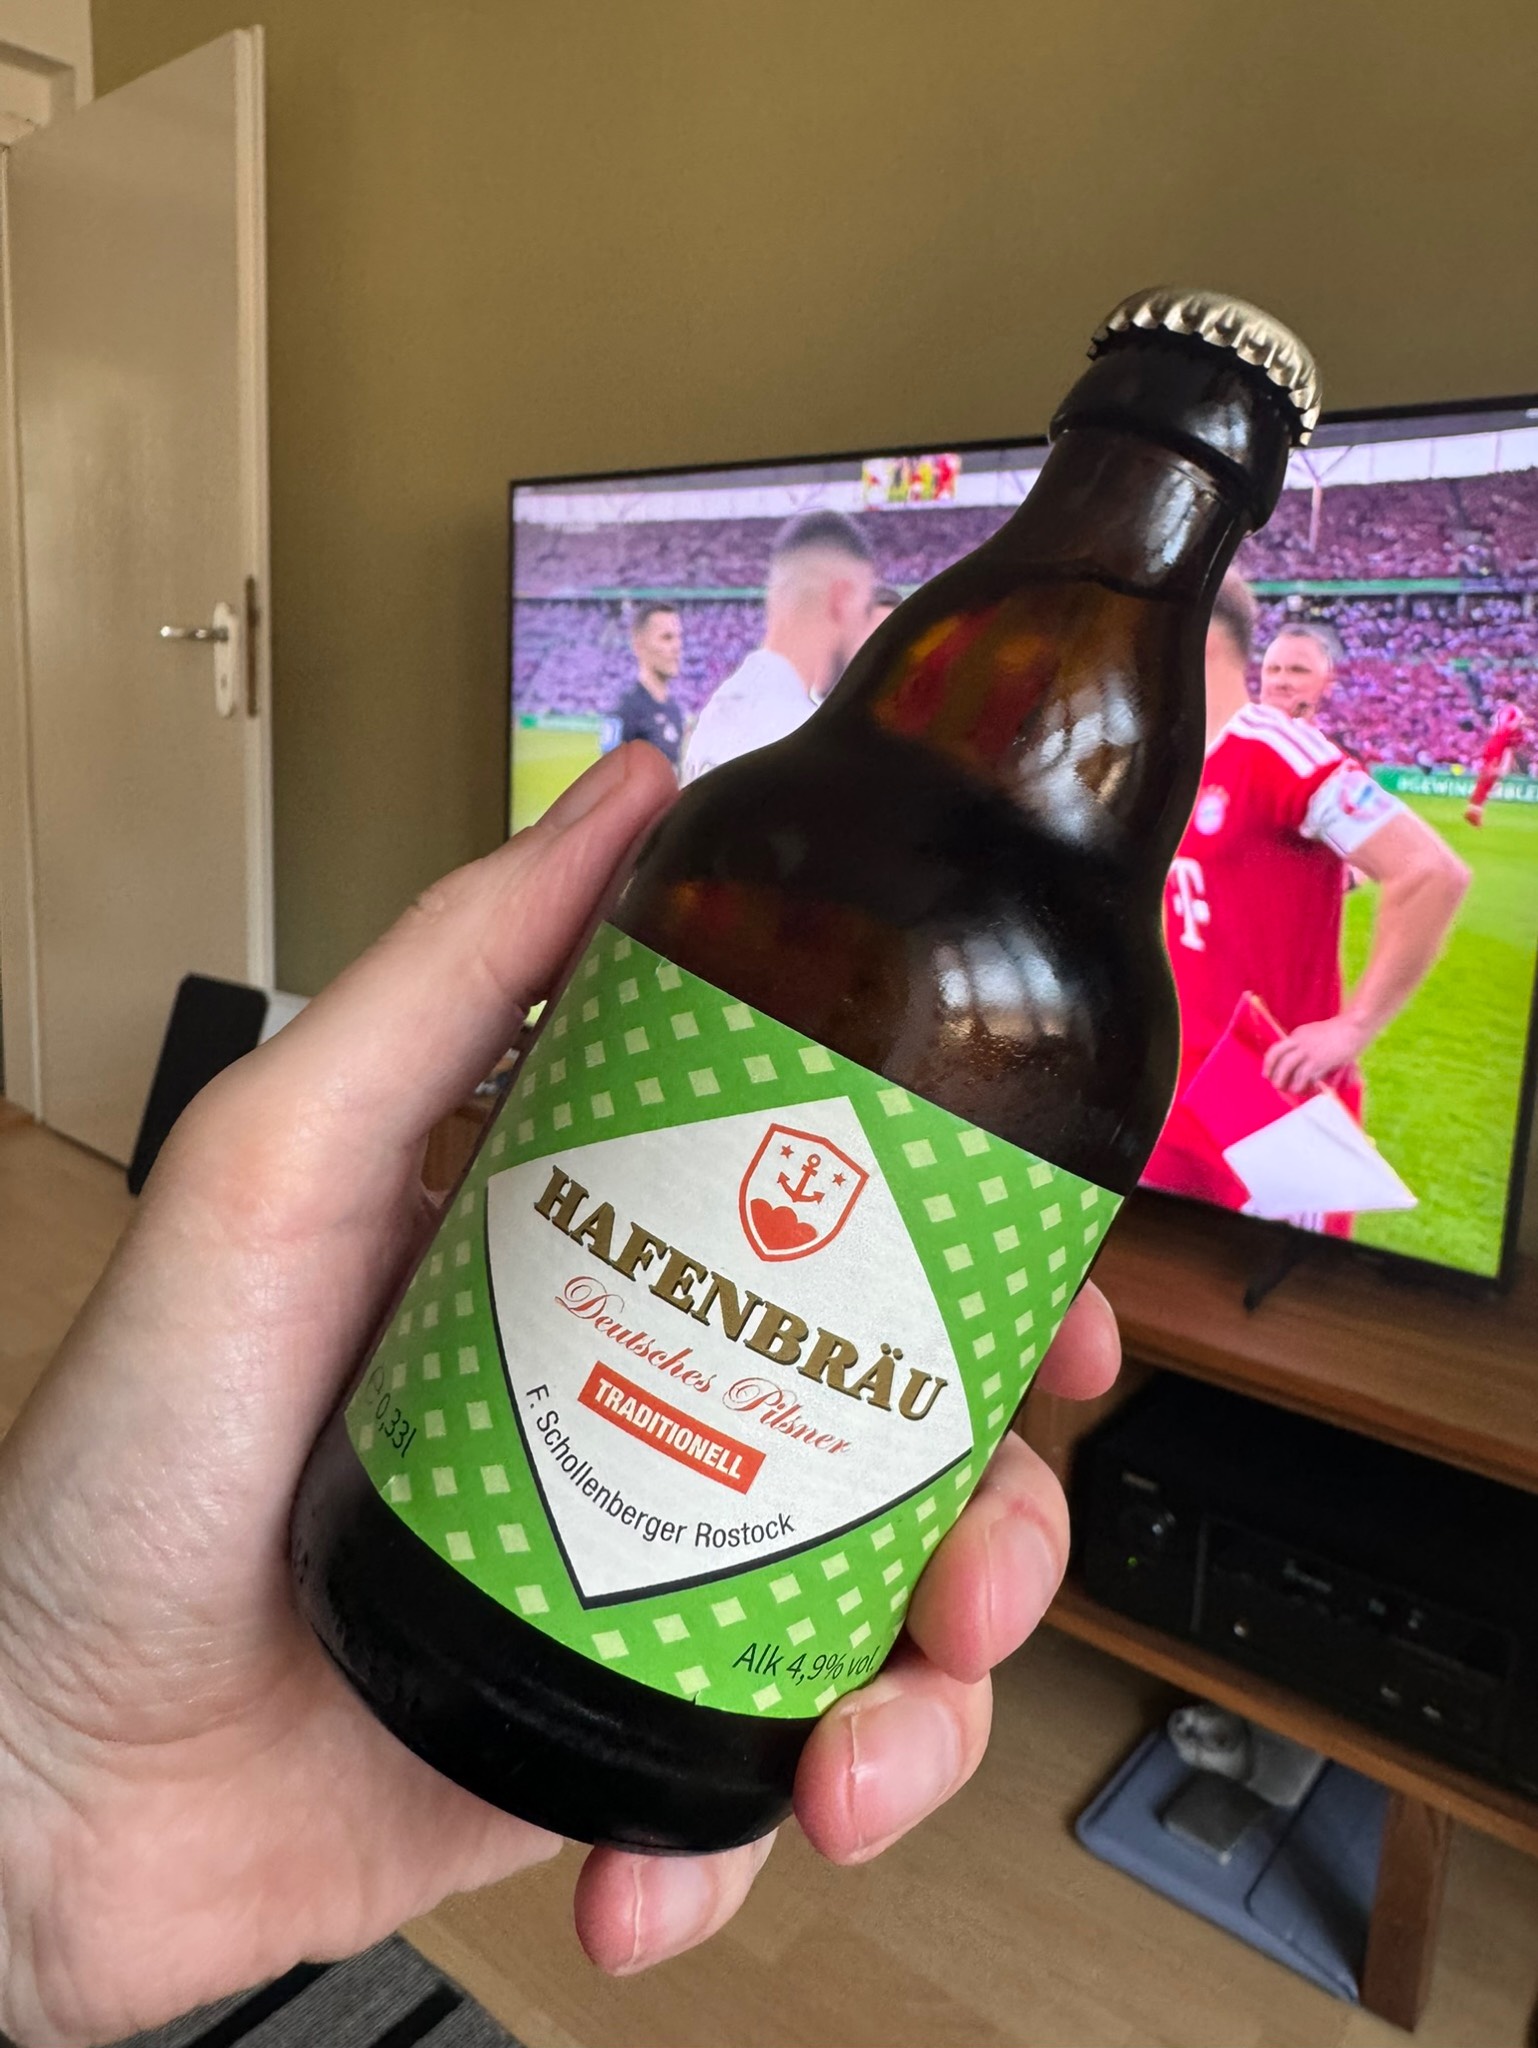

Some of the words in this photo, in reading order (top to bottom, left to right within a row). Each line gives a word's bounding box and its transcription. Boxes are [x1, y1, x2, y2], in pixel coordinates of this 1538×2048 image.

[533, 1164, 948, 1421] HAFENBRÄU
[526, 1383, 549, 1409] F.
[554, 1275, 718, 1394] Deutsches
[722, 1376, 854, 1456] Pilsner
[375, 1392, 417, 1459] 0,33l
[594, 1377, 741, 1480] TRADITIONELL
[536, 1410, 687, 1544] Schollenberger
[694, 1512, 796, 1549] Rostock
[732, 1642, 785, 1676] Alk
[786, 1653, 846, 1686] 4,9%
[847, 1645, 881, 1678] vol.
